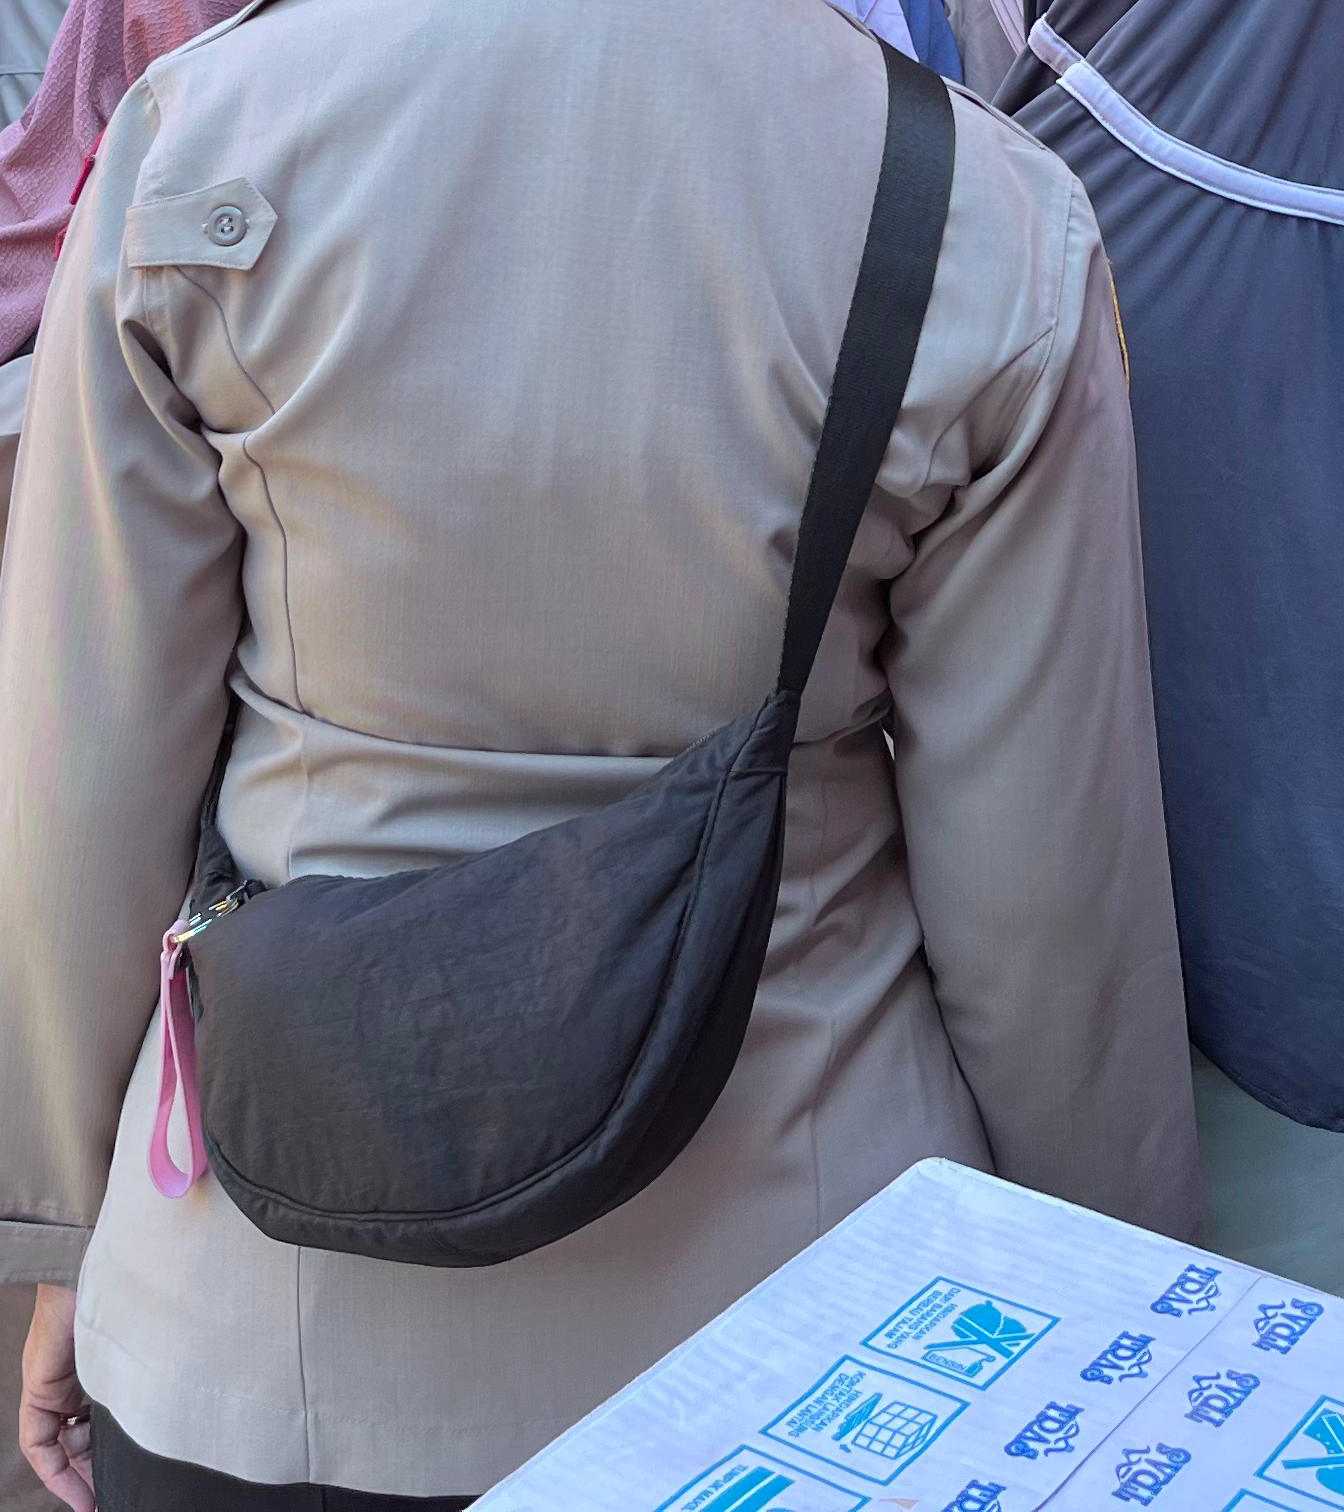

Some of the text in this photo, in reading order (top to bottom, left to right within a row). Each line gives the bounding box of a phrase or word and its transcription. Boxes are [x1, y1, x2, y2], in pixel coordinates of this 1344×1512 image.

[881, 1289, 944, 1339] BERBAU TAJAM
[884, 1286, 961, 1350] DARI BARANG YANG
[910, 1303, 958, 1341] HINDARKAN
[784, 1372, 852, 1428] DENGAN LANTAI
[827, 1370, 868, 1402] KONTAK
[811, 1388, 863, 1432] HINDARKAN
[707, 1460, 749, 1492] TUMPUK
